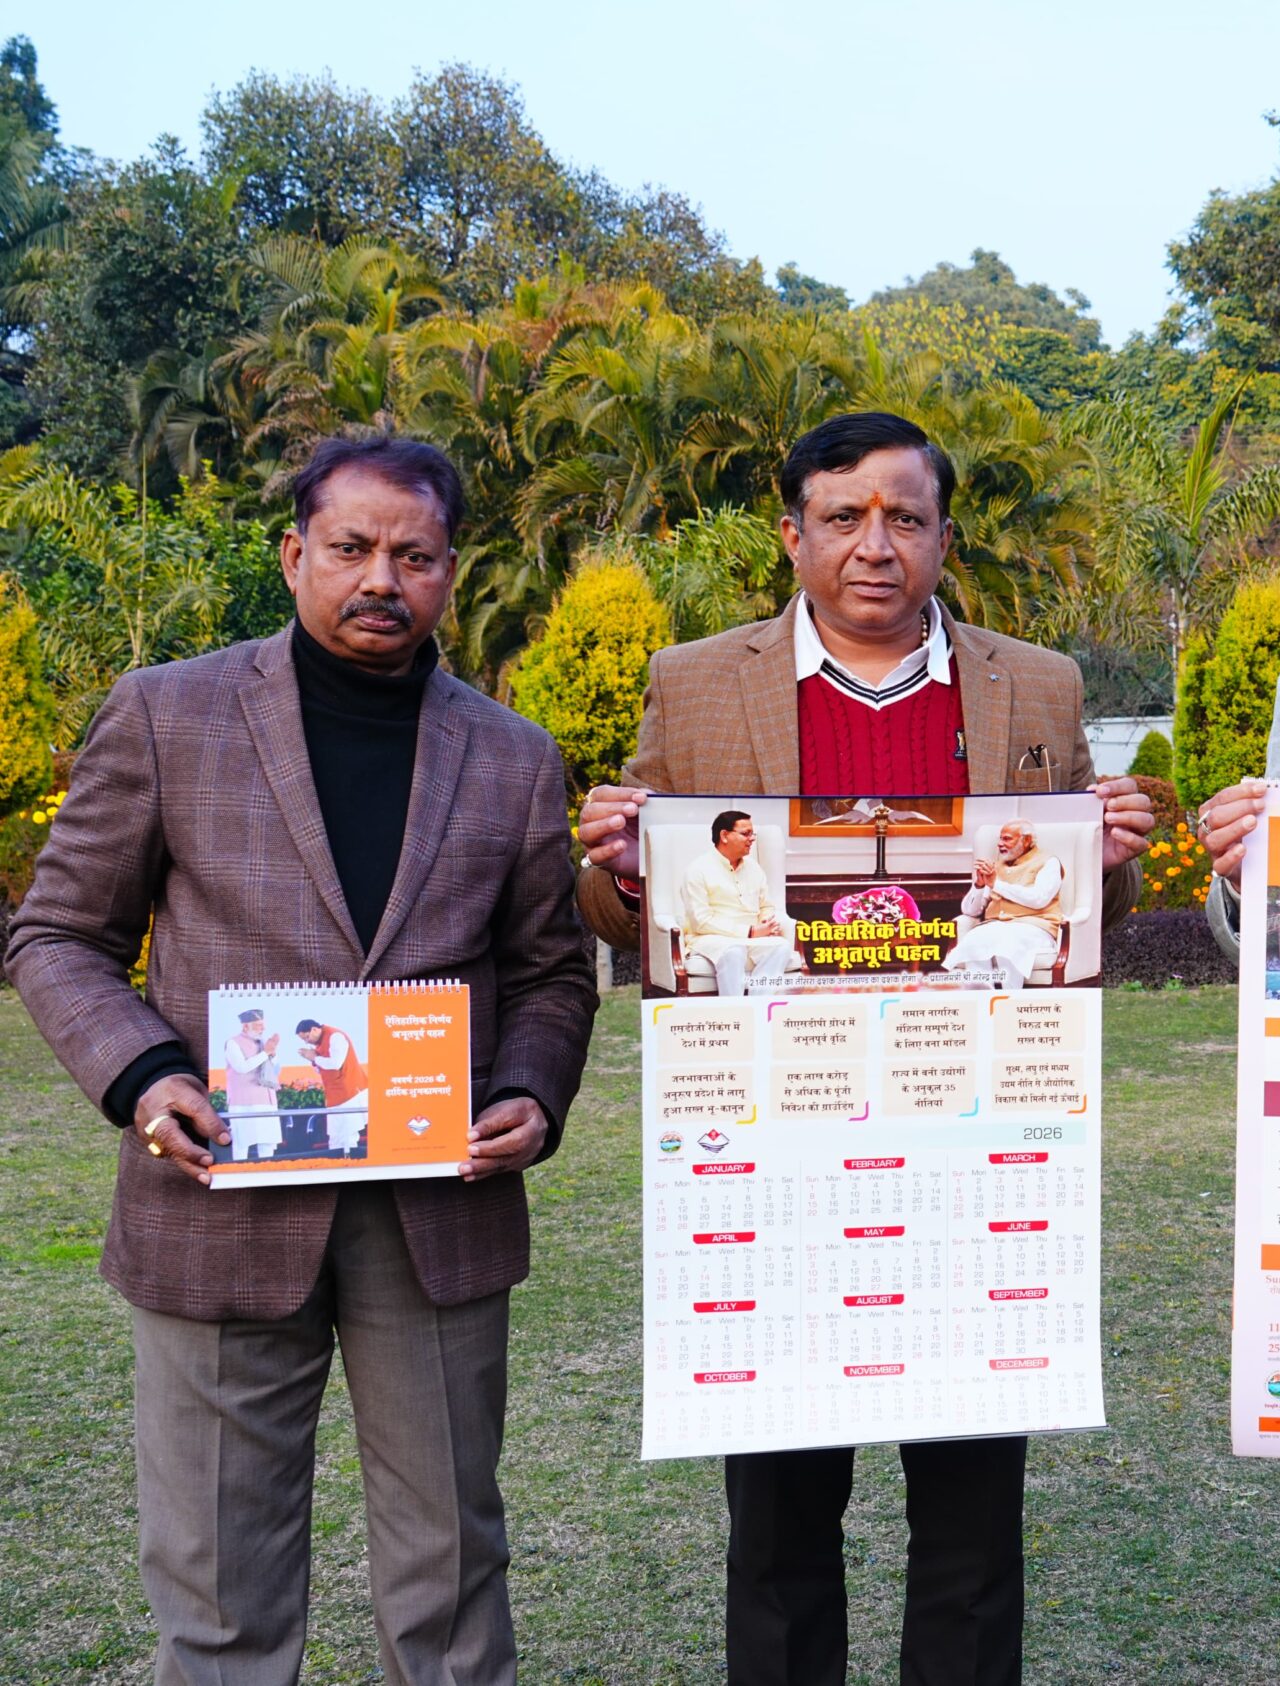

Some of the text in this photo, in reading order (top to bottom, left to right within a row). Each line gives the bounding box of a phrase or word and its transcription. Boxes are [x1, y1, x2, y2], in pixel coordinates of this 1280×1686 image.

[797, 918, 956, 942] ऐतिहासिक निर्णय
[814, 942, 940, 969] अभूतपूर्व पहल
[928, 1007, 959, 1016] नागरिक
[1017, 1004, 1061, 1013] धर्मांतरण के
[1019, 1020, 1041, 1028] विरुद्ध
[681, 1039, 696, 1048] देश
[793, 1033, 846, 1046] अभूतपूर्व वृद्धि
[1024, 1127, 1062, 1140] 2026
[1002, 1153, 1036, 1162] MARCH
[852, 1158, 898, 1168] FEBRUARY
[701, 1164, 746, 1174] JANUARY
[1007, 1222, 1031, 1230] JUNE
[864, 1228, 885, 1236] MAY
[712, 1234, 738, 1242] APRIL
[993, 1289, 1046, 1299] SEPTEMBER
[856, 1296, 893, 1305] AUGUST
[713, 1302, 737, 1312] JULY
[1268, 1344, 1280, 1352] 25
[996, 1360, 1044, 1368] DECEMBER
[850, 1365, 900, 1375] NOVEMBER
[704, 1372, 748, 1382] OCTOBER
